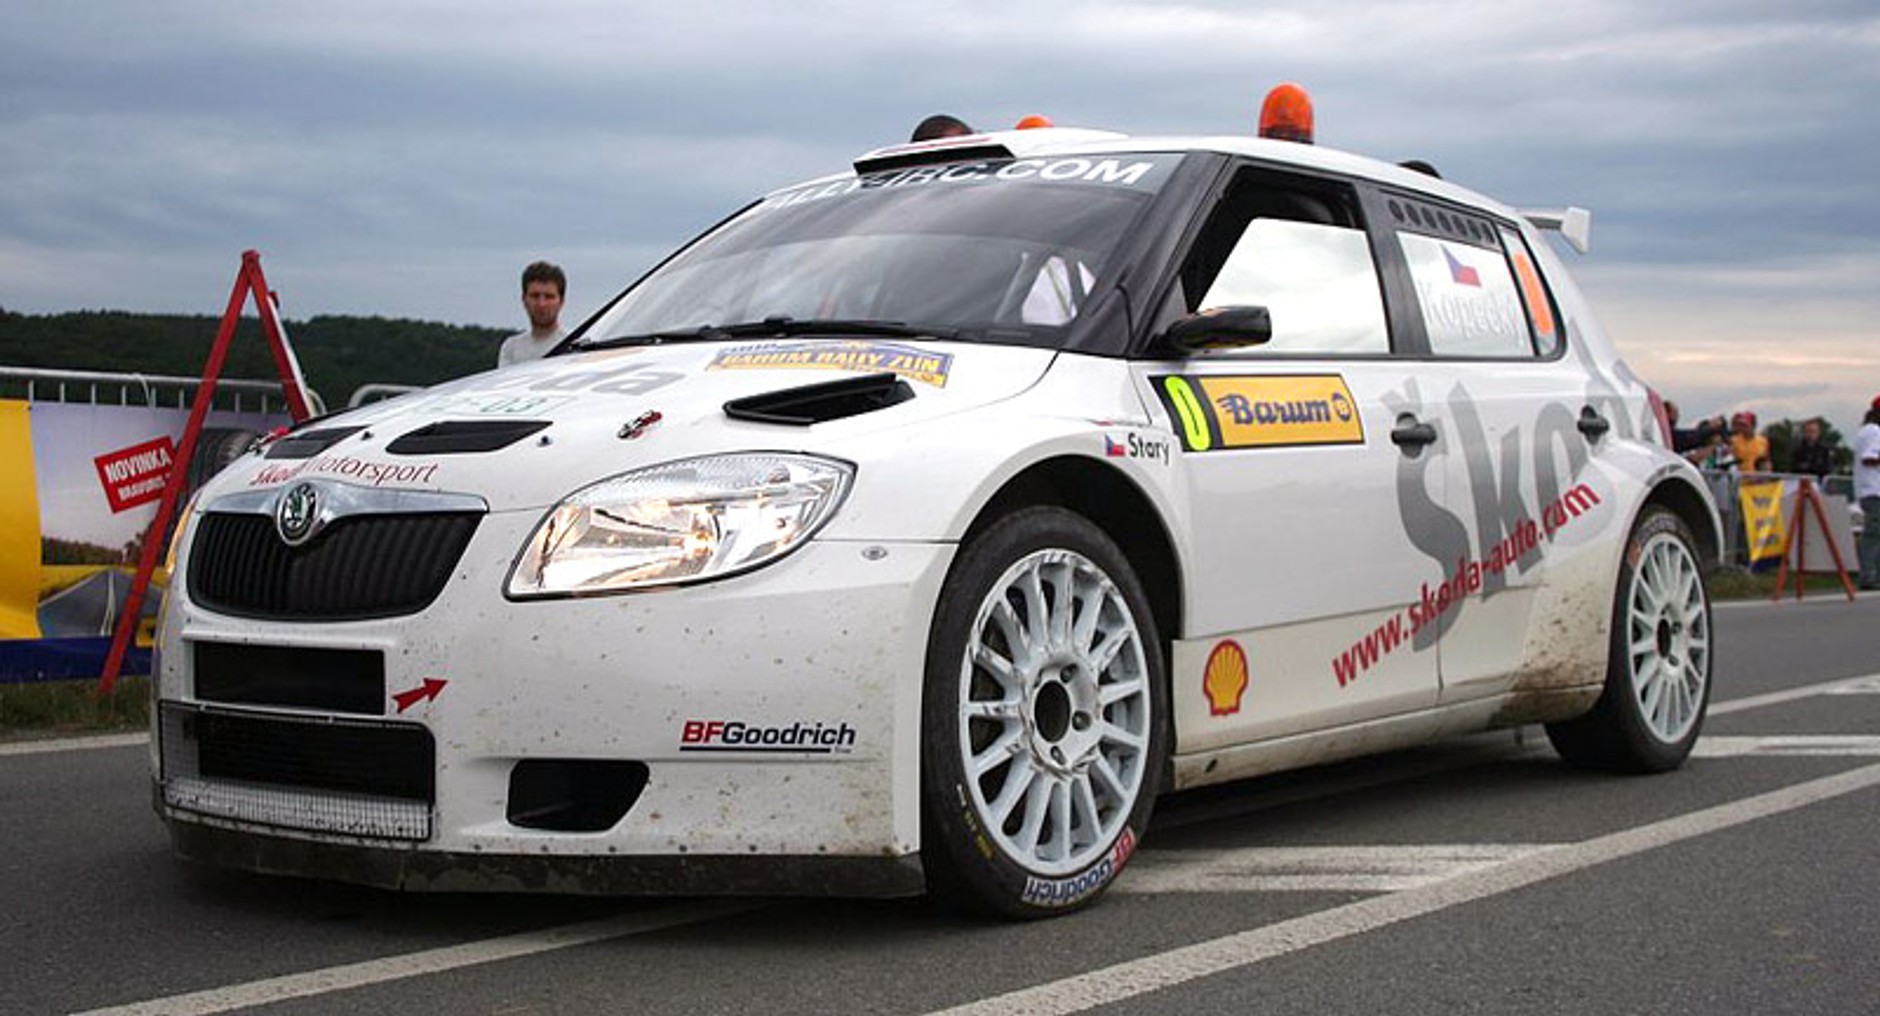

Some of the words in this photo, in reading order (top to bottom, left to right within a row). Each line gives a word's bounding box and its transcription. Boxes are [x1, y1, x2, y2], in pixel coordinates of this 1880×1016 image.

[816, 350, 885, 367] RALLY
[1165, 375, 1211, 451] 0
[1222, 393, 1331, 425] Barum
[104, 446, 172, 484] NOVINKA
[1331, 480, 1601, 689] www.skoda-auto.com
[681, 720, 857, 746] BFGoodrich
[1023, 826, 1137, 902] BFGoodrich
